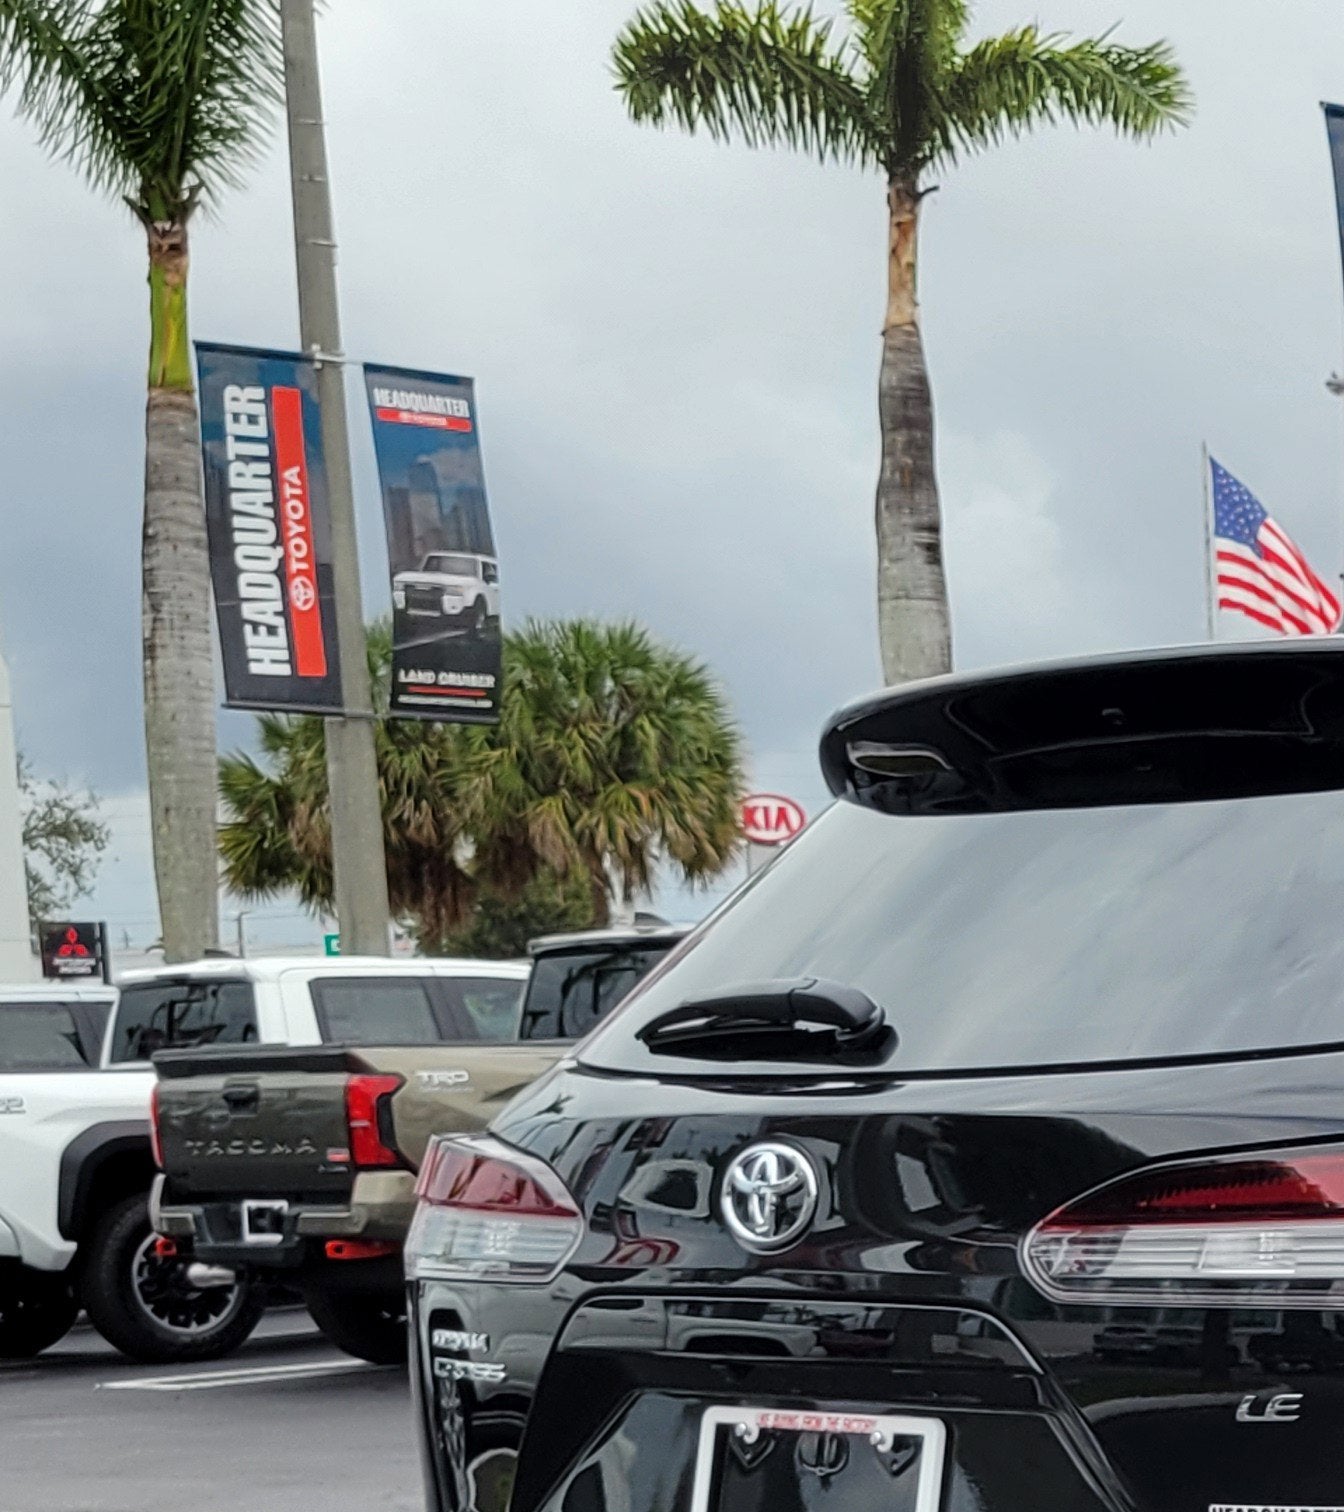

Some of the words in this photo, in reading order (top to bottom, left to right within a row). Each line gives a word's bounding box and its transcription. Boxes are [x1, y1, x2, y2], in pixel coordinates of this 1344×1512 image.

[223, 384, 292, 676] HEADQUARTER
[283, 465, 308, 572] TOYOTA
[398, 668, 436, 684] LAND
[743, 806, 795, 832] KIA
[184, 1138, 317, 1156] TACOMA
[1235, 1393, 1304, 1422] LE
